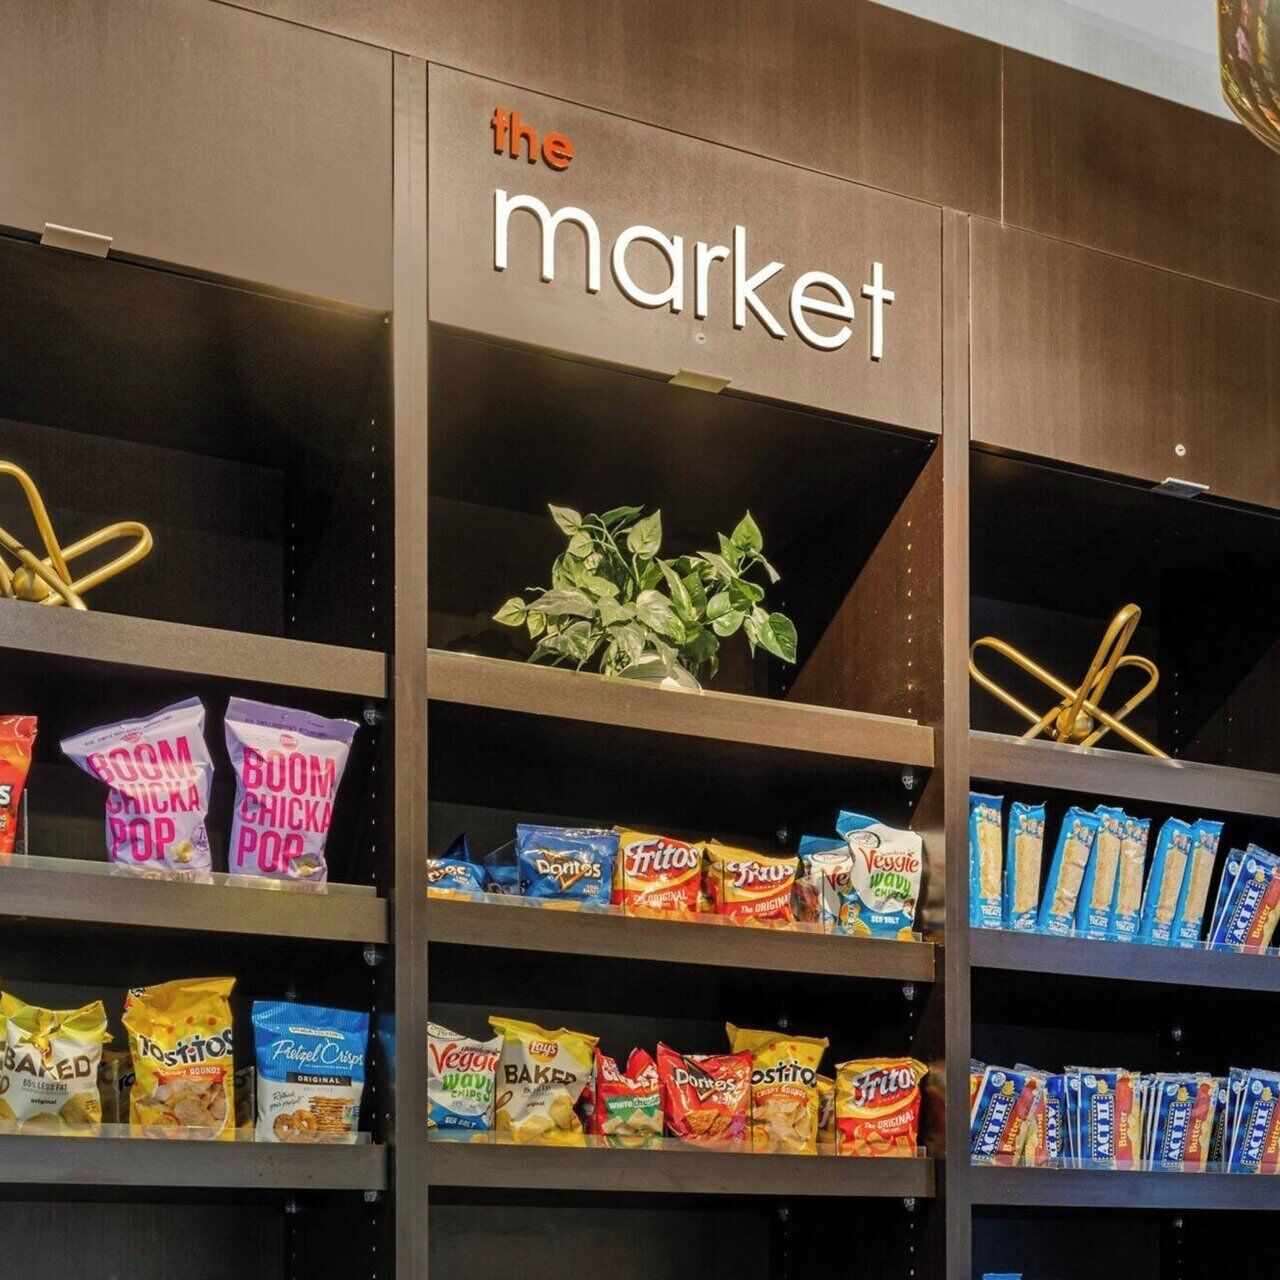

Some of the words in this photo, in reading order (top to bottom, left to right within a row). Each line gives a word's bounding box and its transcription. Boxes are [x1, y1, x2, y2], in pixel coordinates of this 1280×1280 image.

[491, 107, 575, 170] the
[493, 189, 895, 361] market
[86, 735, 196, 785] BOOM
[242, 746, 336, 799] BOOM
[106, 782, 200, 814] CHICKA
[241, 791, 333, 834] CHICKA
[109, 817, 176, 862] POP
[237, 825, 305, 875] POP
[536, 859, 602, 879] Doritos
[625, 838, 699, 878] Fritos
[859, 847, 920, 875] Veggie
[648, 889, 688, 904] ORIGINAL
[870, 872, 912, 900] wavy
[741, 905, 753, 913] The
[1232, 907, 1252, 941] ACT
[1251, 904, 1271, 939] Butter
[271, 1039, 319, 1070] Pretzel
[320, 1038, 364, 1069] Crisps
[530, 1041, 557, 1056] Lay's
[37, 1081, 56, 1091] LESS
[55, 1082, 69, 1091] FAT
[297, 1075, 341, 1084] ORIGINAL
[442, 1073, 494, 1103] wavy
[504, 1063, 577, 1086] BAKED
[674, 1067, 737, 1092] Doritos
[451, 1089, 483, 1101] CHIPS
[444, 1116, 457, 1124] SEA
[458, 1118, 477, 1127] SALT
[877, 1110, 915, 1129] ORIGINAL
[1003, 1116, 1022, 1152] Butter
[1118, 1110, 1128, 1147] Butter
[981, 1121, 1001, 1156] ACT
[1097, 1122, 1110, 1156] ACT
[1169, 1130, 1183, 1161] ACT
[1189, 1119, 1203, 1154] Butter
[1248, 1127, 1265, 1159] ACT
